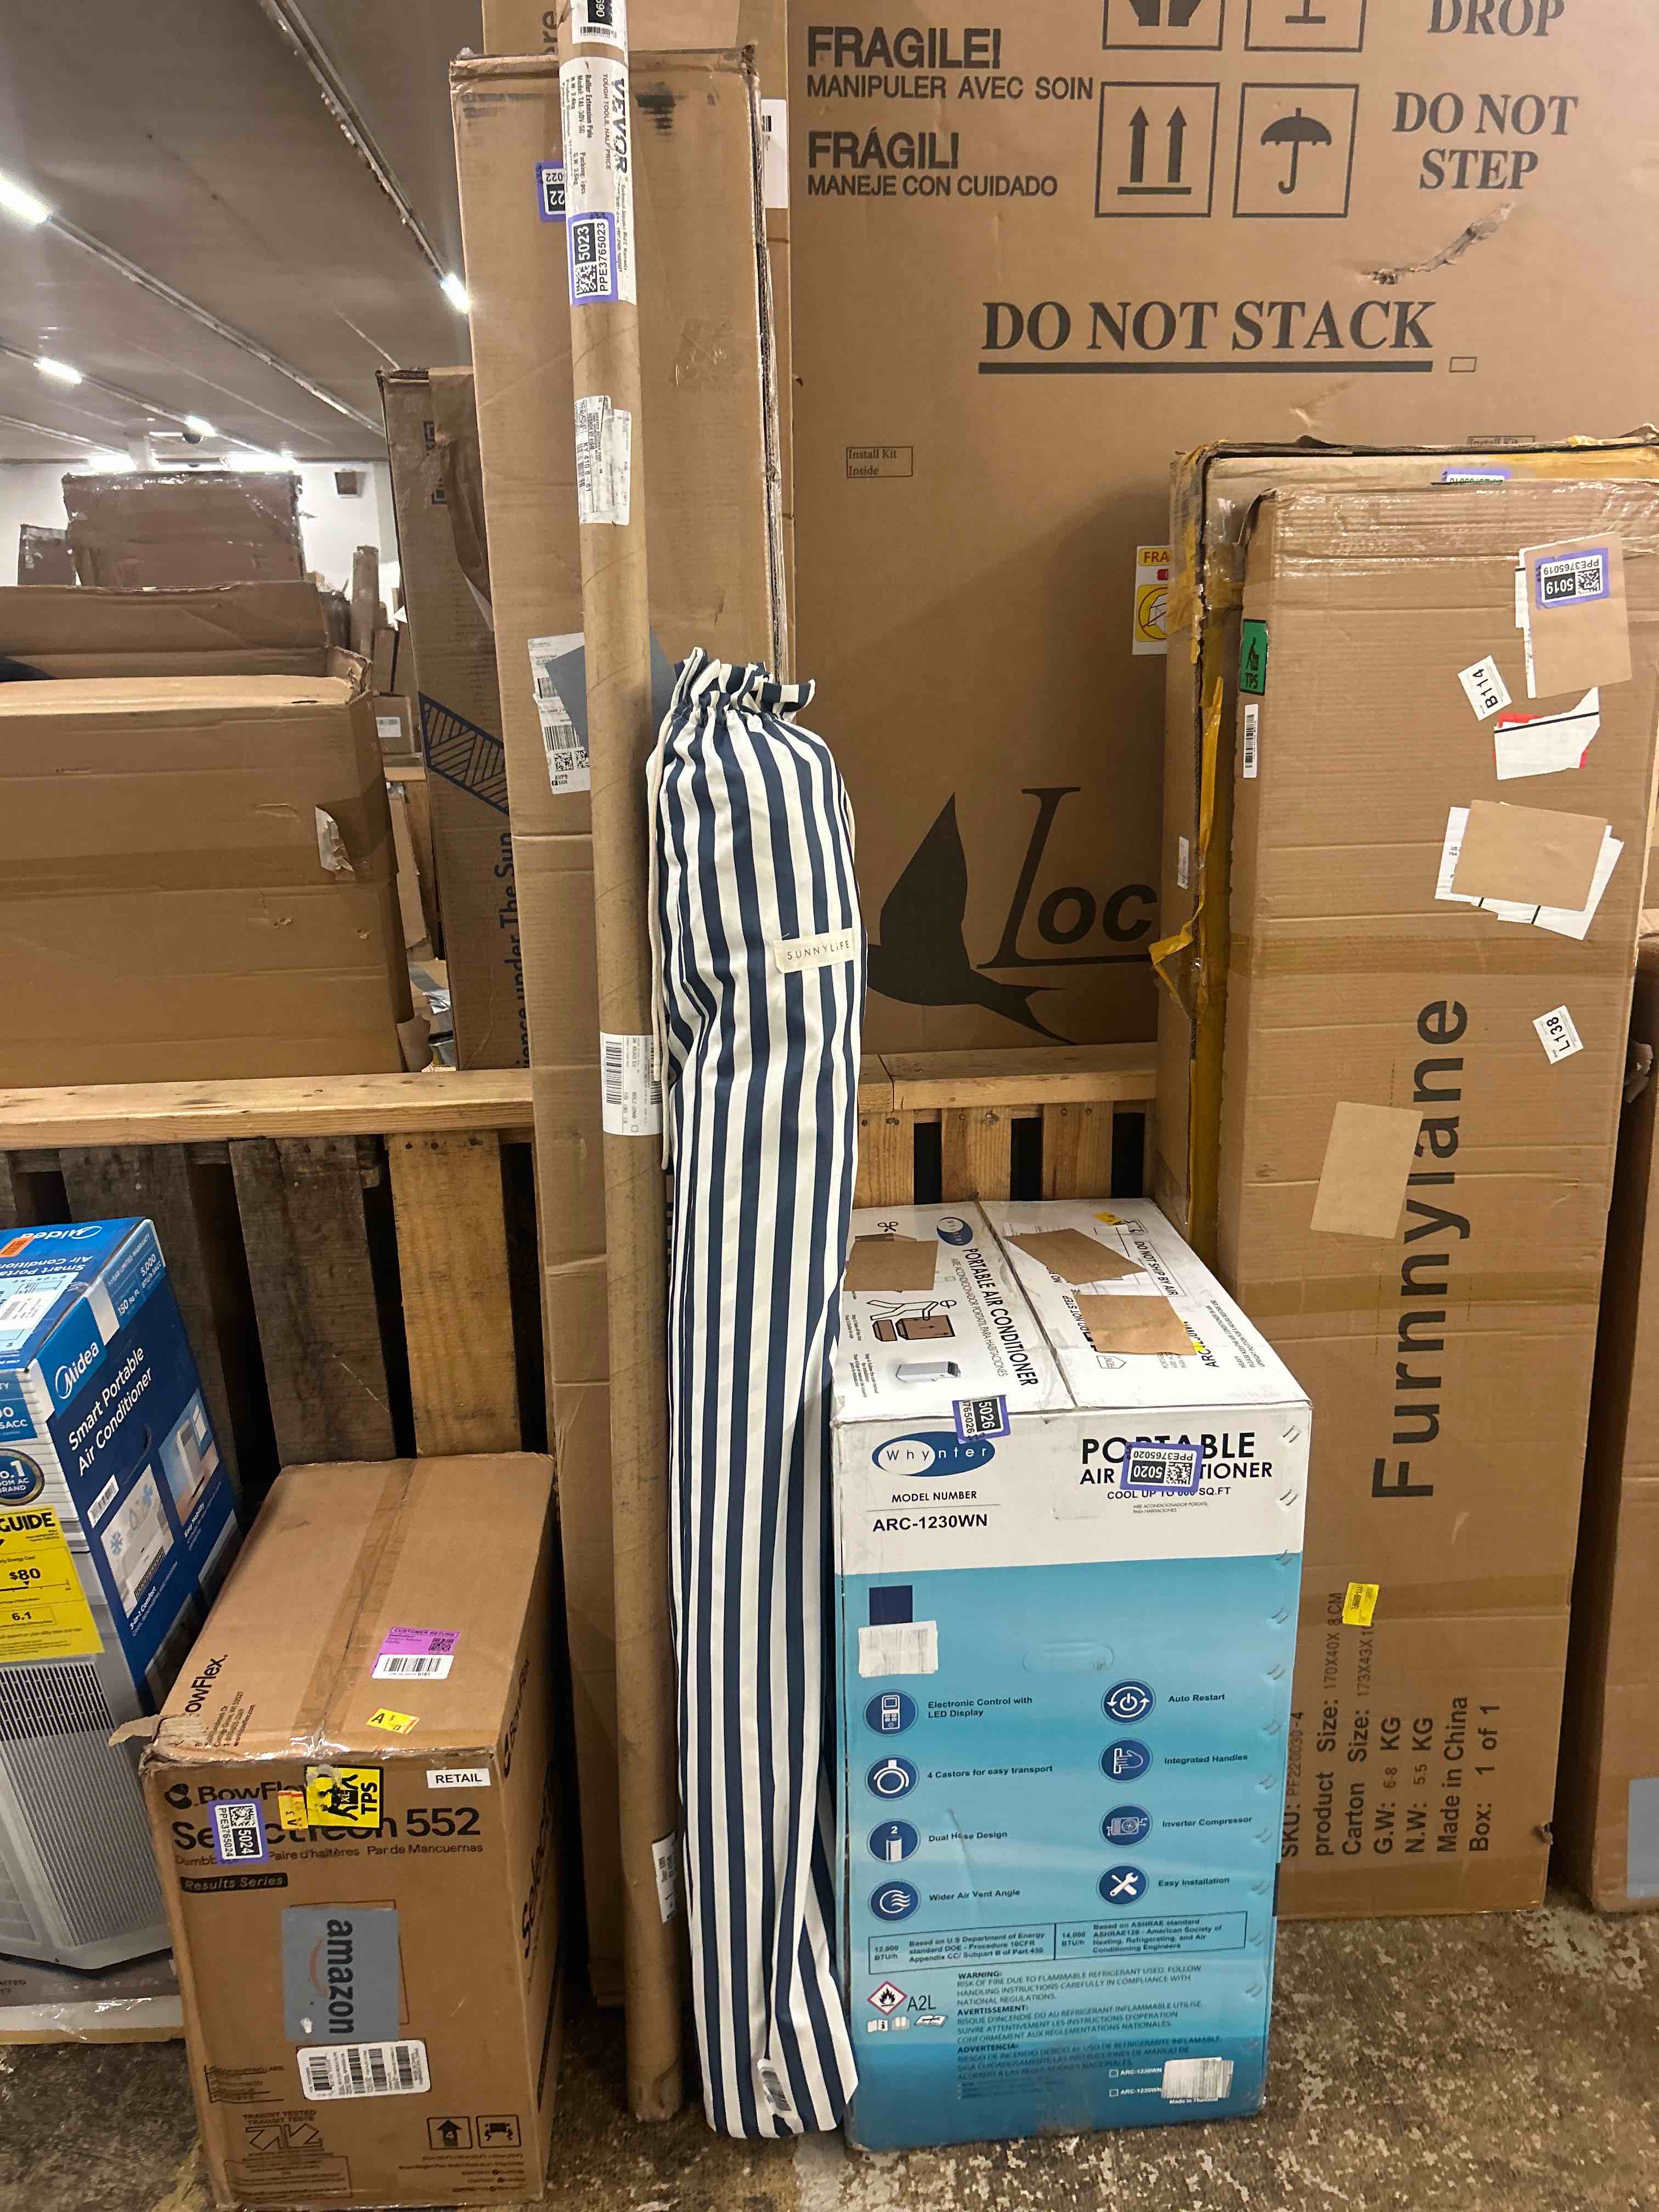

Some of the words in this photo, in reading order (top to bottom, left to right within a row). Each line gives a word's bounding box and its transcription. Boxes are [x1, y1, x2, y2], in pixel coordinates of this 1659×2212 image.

[1427, 0, 1566, 37] DROP
[808, 26, 1001, 69] FRAGILE!
[808, 75, 946, 99] MANIPULER
[958, 76, 1023, 99] AVEC
[1035, 77, 1093, 100] SOIN
[612, 78, 628, 174] VEVOR
[1392, 92, 1464, 132] DO
[1474, 94, 1578, 136] NOT
[809, 127, 959, 169] FRÁGIL!
[1419, 149, 1538, 190] STEP
[808, 176, 895, 196] MANEJE
[902, 176, 950, 196] CON
[957, 176, 1057, 196] CUIDADO
[577, 225, 590, 261] 5023
[597, 222, 608, 291] PPE3765023
[981, 302, 1071, 351] DO
[1087, 301, 1217, 351] NOT
[1231, 300, 1437, 351] STACK
[848, 448, 880, 460] Install
[882, 448, 898, 460] Kit
[848, 465, 879, 476] Inside
[1144, 551, 1169, 562] FRA
[1543, 558, 1599, 575] PPE3765019
[1546, 578, 1573, 595] 5019
[1472, 668, 1498, 709] B114
[495, 833, 516, 878] Sun
[977, 787, 1159, 969] Loc
[500, 885, 518, 929] The
[1547, 1017, 1570, 1051] L138
[1371, 1000, 1470, 1498] Furnnylane
[41, 1264, 86, 1273] Smart
[962, 1248, 996, 1289] PORTABLE
[1135, 1242, 1145, 1251] DO
[1142, 1250, 1156, 1263] NOT
[1164, 1285, 1178, 1295] AIR
[983, 1289, 1003, 1307] AIR
[990, 1308, 1039, 1386] CONDITIONER
[55, 1341, 99, 1399] Midea
[69, 1401, 103, 1451] Smart
[102, 1347, 144, 1407] Portable
[78, 1441, 95, 1476] Air
[95, 1368, 152, 1448] Conditioner
[962, 1400, 975, 1433] 765026
[978, 1401, 995, 1429] 5026
[887, 1447, 986, 1461] Whynter
[1082, 1432, 1255, 1464] POBLE
[1133, 1451, 1193, 1461] PPE3765020
[0, 1460, 25, 1478] o.1
[1080, 1468, 1115, 1485] AIR
[1200, 1462, 1273, 1479] TIONER
[1133, 1465, 1164, 1479] 5020
[891, 1493, 930, 1503] MODEL
[933, 1491, 977, 1500] NUMBER
[1107, 1491, 1138, 1499] COOL
[1142, 1489, 1156, 1498] UP
[1199, 1487, 1231, 1496] SQ.FT
[872, 1514, 988, 1532] ARC-1230WN
[9, 1568, 41, 1581] $80
[12, 1612, 32, 1621] 6.1
[1328, 1593, 1342, 1615] CM
[928, 1699, 974, 1708] Electronic
[977, 1697, 1011, 1706] Control
[1013, 1696, 1032, 1705] with
[1168, 1694, 1190, 1702] Auto
[1480, 1705, 1500, 1715] 1
[371, 1713, 385, 1724] A
[950, 1709, 984, 1718] Display
[1317, 1700, 1339, 1752] Size:
[1347, 1710, 1370, 1762] Size:
[1380, 1717, 1400, 1750] KG
[1412, 1717, 1433, 1751] KG
[1444, 1697, 1467, 1760] China
[1478, 1729, 1497, 1750] of
[935, 1770, 970, 1779] Castors
[988, 1768, 1008, 1777] easy
[1011, 1765, 1053, 1775] transport
[1164, 1755, 1209, 1765] Integrated
[1212, 1753, 1248, 1762] Handles
[1476, 1766, 1494, 1775] 1
[436, 1773, 482, 1784] RETAIL
[1442, 1769, 1462, 1787] in
[361, 1782, 377, 1814] TPS
[407, 1808, 481, 1837] 552
[1162, 1819, 1197, 1828] Inverter
[1199, 1816, 1252, 1827] Compressor
[1313, 1772, 1334, 1856] product
[1342, 1782, 1365, 1855] Carton
[1437, 1795, 1460, 1852] Made
[1469, 1803, 1492, 1851] Box:
[219, 1808, 233, 1857] PPE3765024
[929, 1833, 949, 1842] Dual
[977, 1831, 1007, 1839] Design
[1282, 1804, 1301, 1857] SKU:
[1374, 1803, 1396, 1854] G.W:
[1405, 1803, 1426, 1853] N.W:
[238, 1829, 255, 1855] 5024
[367, 1845, 388, 1855] Par
[392, 1845, 406, 1854] de
[408, 1844, 483, 1854] Mancuernas
[184, 1878, 237, 1891] Results
[240, 1875, 283, 1887] Series
[995, 1889, 1020, 1898] Angle
[1158, 1879, 1179, 1888] Easy
[1182, 1877, 1229, 1886] Installation
[962, 1934, 1006, 1943] Department
[326, 1919, 355, 2035] amazon
[907, 1995, 936, 2012] A2L
